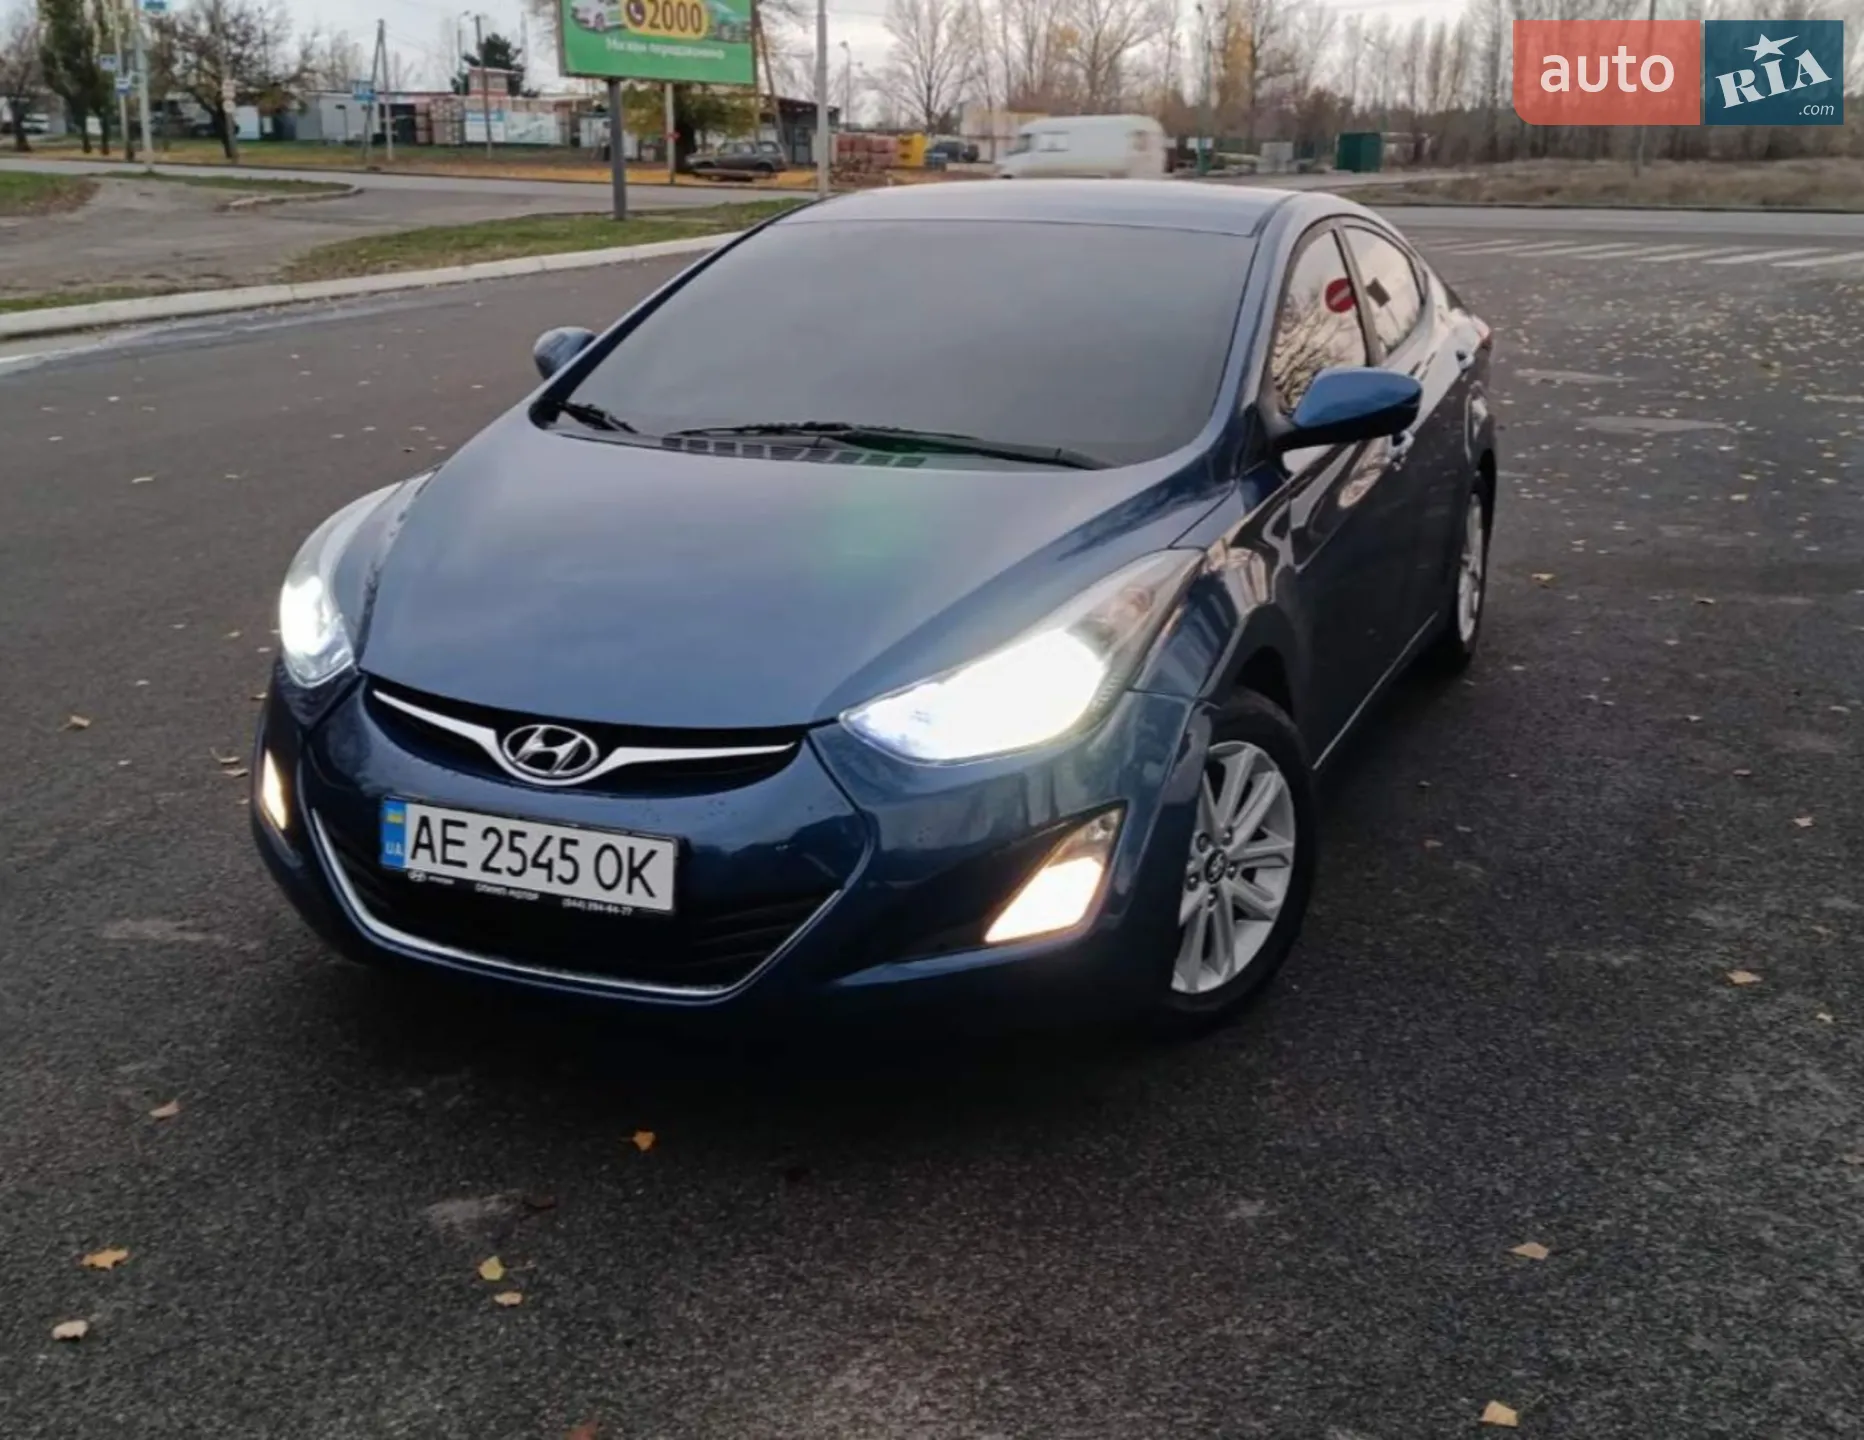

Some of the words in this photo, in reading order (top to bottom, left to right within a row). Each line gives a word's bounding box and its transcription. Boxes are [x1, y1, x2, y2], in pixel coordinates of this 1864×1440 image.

[647, 0, 702, 34] 2000
[385, 841, 404, 857] UA
[410, 815, 468, 868] AE
[481, 827, 580, 885] 2545
[594, 843, 658, 899] OK
